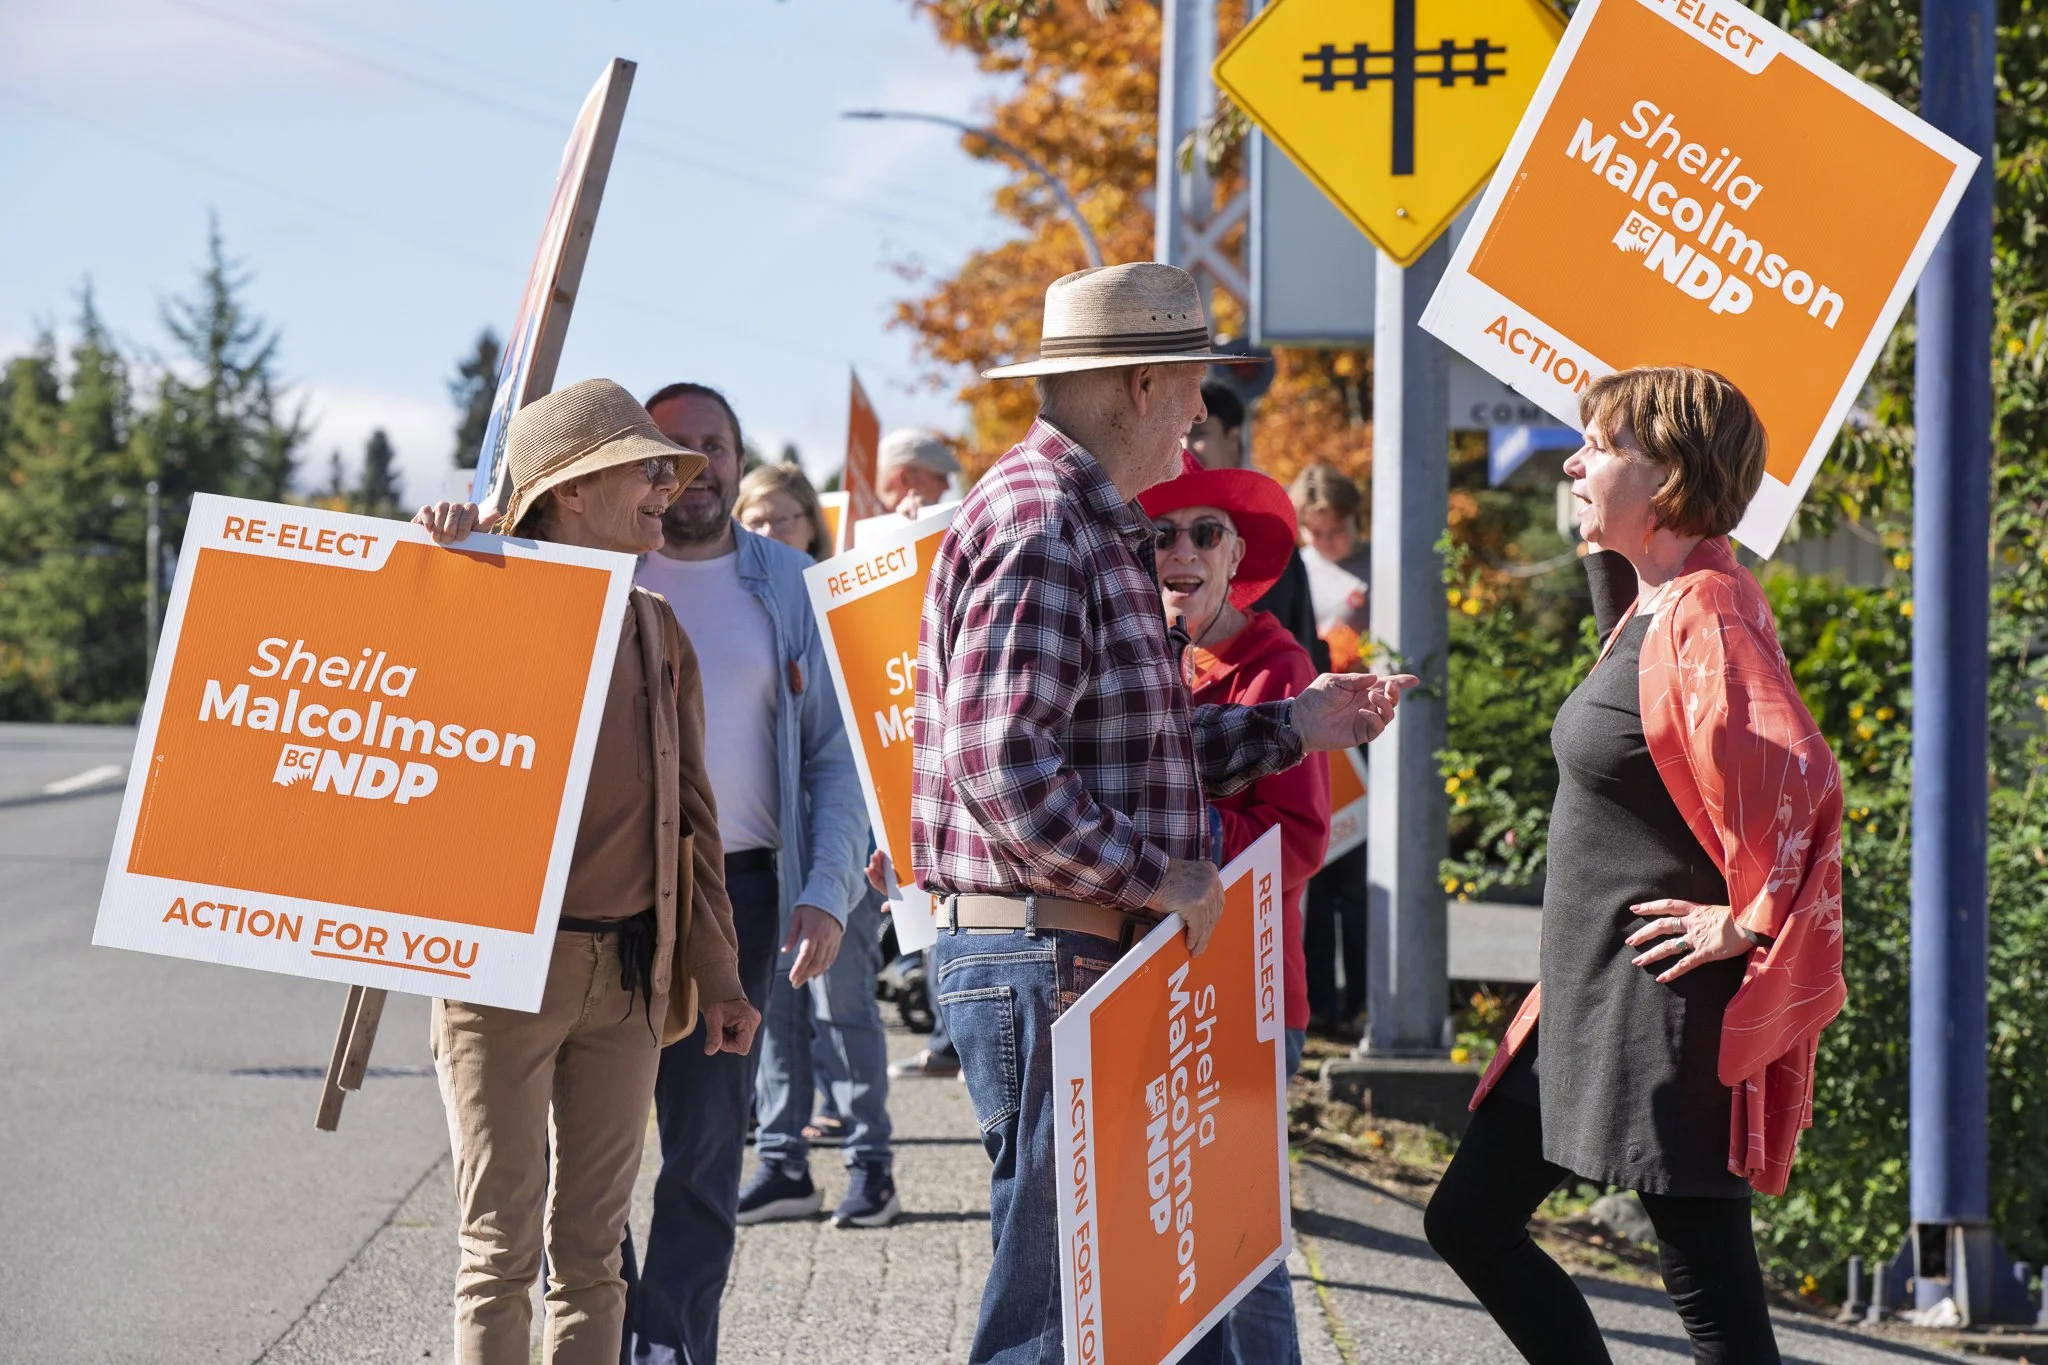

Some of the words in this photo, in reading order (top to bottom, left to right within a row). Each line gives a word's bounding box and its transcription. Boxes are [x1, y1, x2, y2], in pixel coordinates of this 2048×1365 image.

[1658, 0, 1764, 58] ELECT
[1620, 99, 1764, 211] Sheila
[1565, 118, 1844, 329] Malcolmson
[1626, 216, 1655, 244] BC
[1643, 230, 1754, 315] NDP
[1469, 402, 1556, 425] COM
[223, 515, 379, 561] RE-ELECT
[828, 546, 908, 597] RE-ELECT
[248, 637, 418, 698] Sheila
[198, 680, 537, 770] Malcolmson
[283, 749, 316, 770] BC
[312, 749, 439, 805] NDP
[162, 896, 303, 943] ACTION
[312, 918, 389, 956] FOR
[402, 931, 480, 970] YOU
[1258, 872, 1275, 1024] RE-ELECT
[1194, 983, 1220, 1149] Sheila
[1070, 1078, 1089, 1216] ACTION
[1146, 1112, 1172, 1235] NDP
[1167, 960, 1198, 1305] Malcolmson
[1076, 1220, 1093, 1302] FOR
[1081, 1302, 1097, 1365] YO
